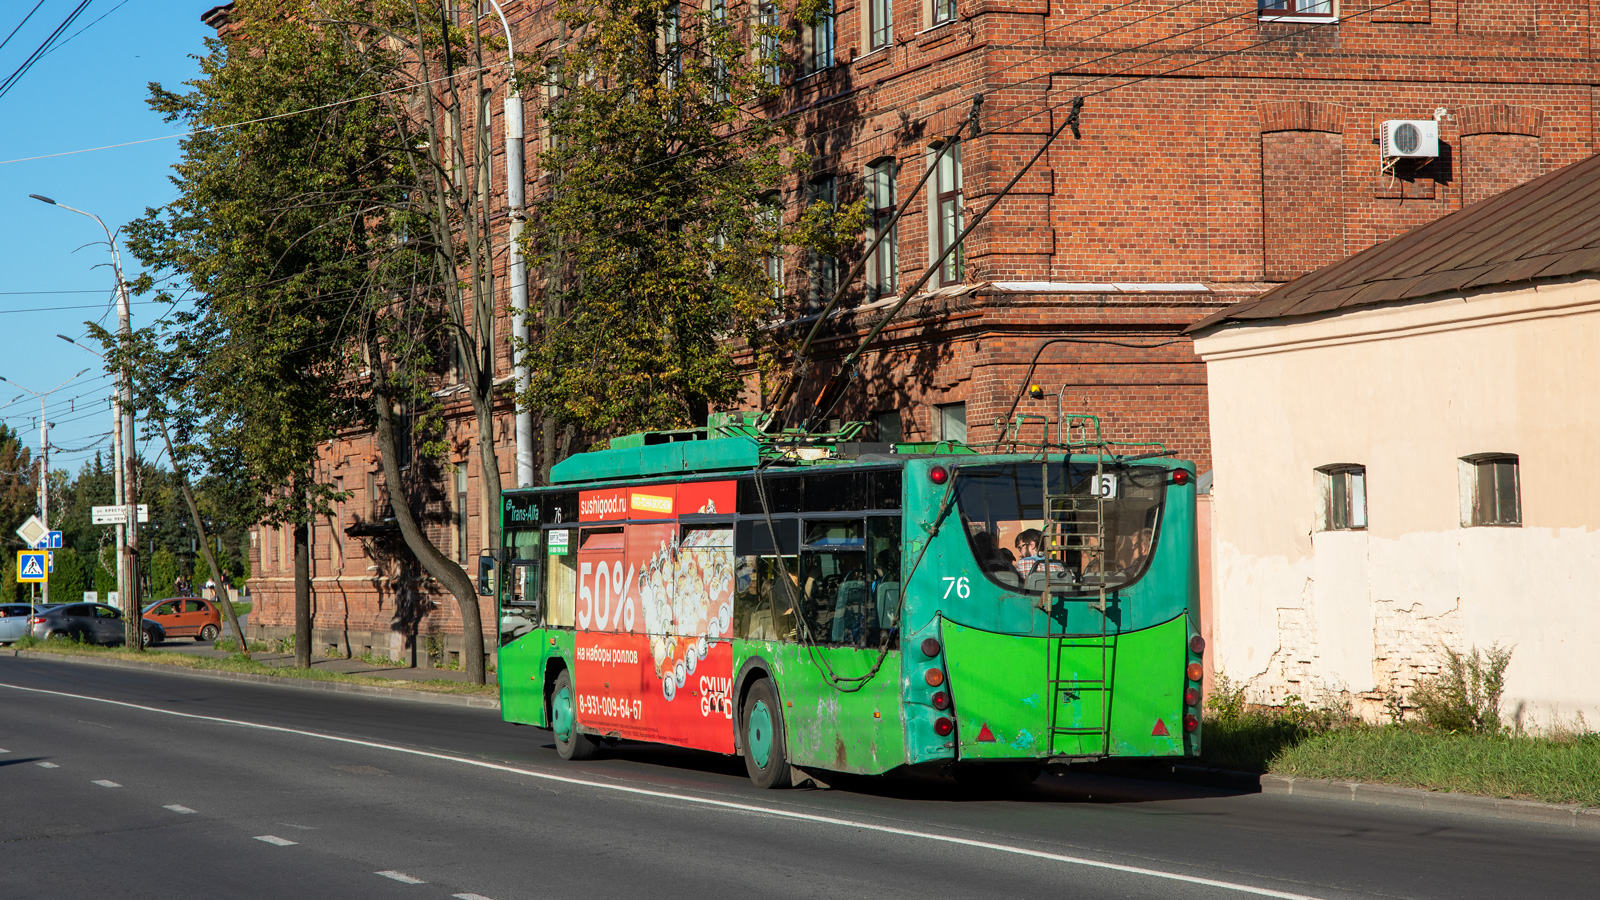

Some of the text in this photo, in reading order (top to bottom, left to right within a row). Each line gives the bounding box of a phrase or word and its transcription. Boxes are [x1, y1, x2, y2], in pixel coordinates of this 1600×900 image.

[1101, 477, 1111, 497] 6
[511, 504, 539, 521] Trans-Alfa
[554, 507, 562, 524] 76
[580, 494, 627, 519] sushigood.ru
[578, 560, 635, 632] 50%
[942, 576, 971, 600] 76
[576, 644, 638, 668] на наборы роллов
[700, 675, 733, 699] СУШИ
[579, 694, 642, 720] 8-931-009-64-67
